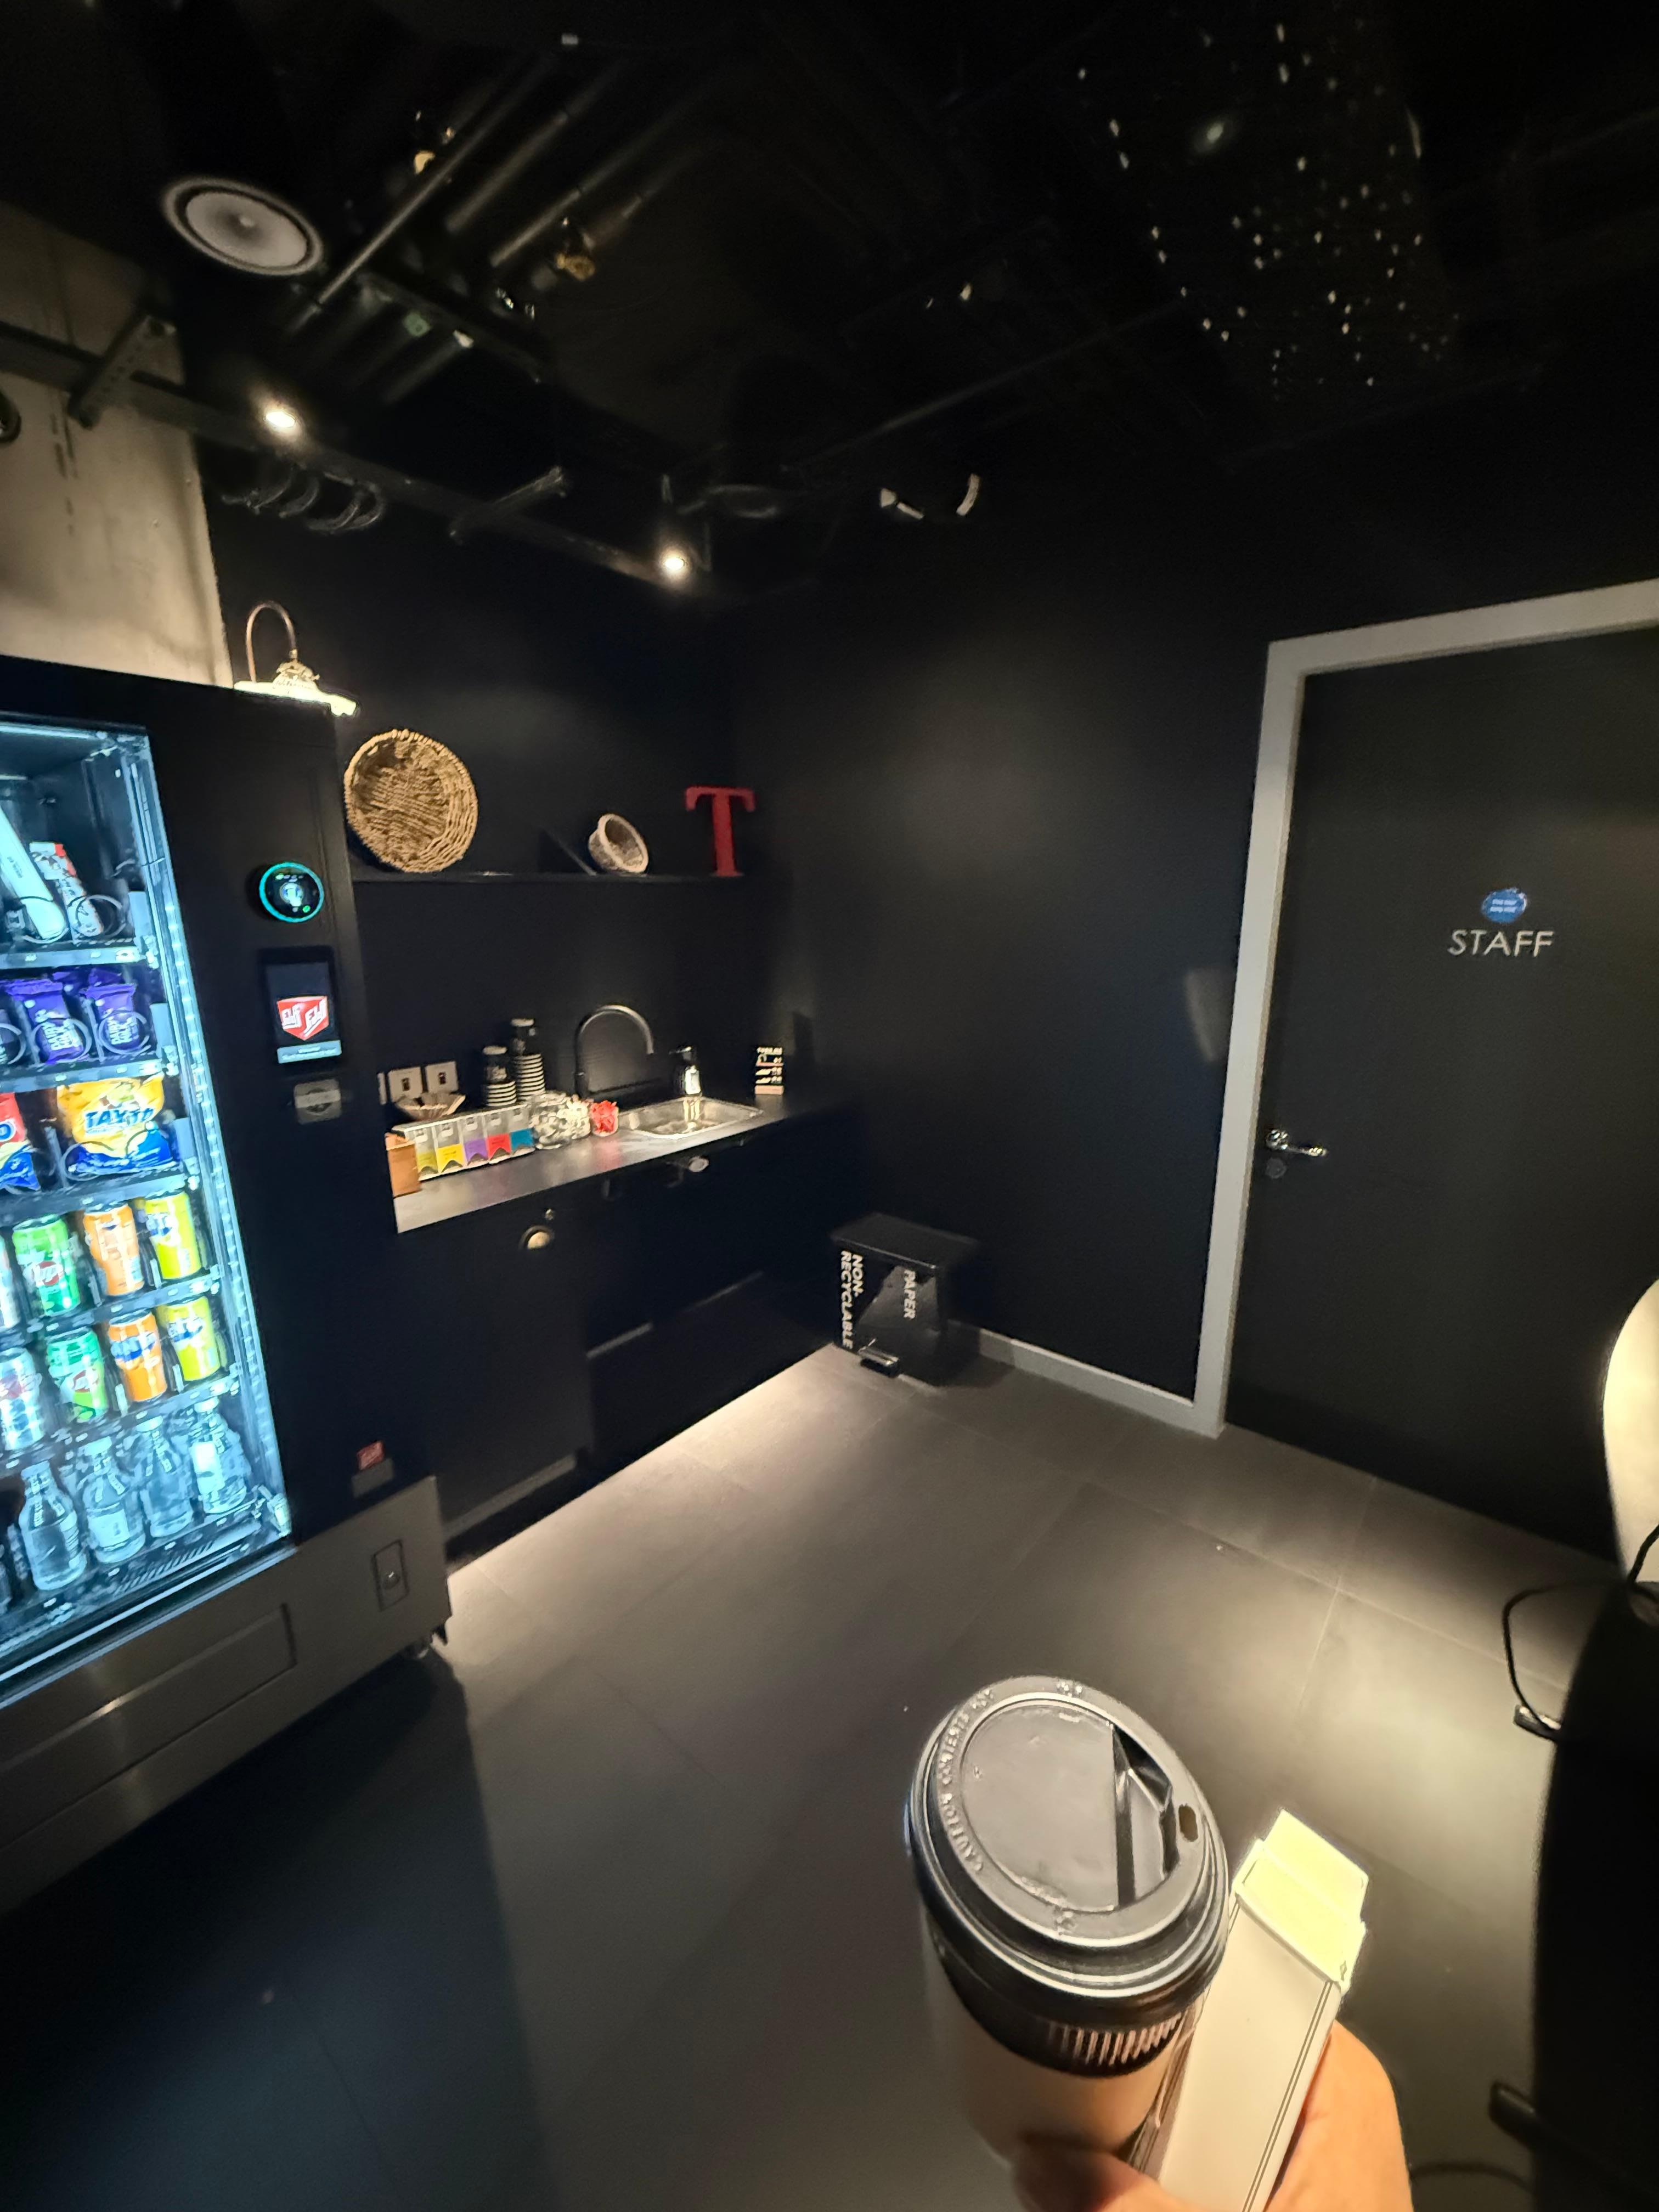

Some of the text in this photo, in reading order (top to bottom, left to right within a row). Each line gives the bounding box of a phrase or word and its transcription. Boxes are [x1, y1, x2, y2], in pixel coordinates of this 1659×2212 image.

[685, 786, 755, 877] T
[1447, 929, 1554, 957] STAFF
[841, 1250, 854, 1349] RECYCLABLE
[904, 1269, 916, 1319] PAPER
